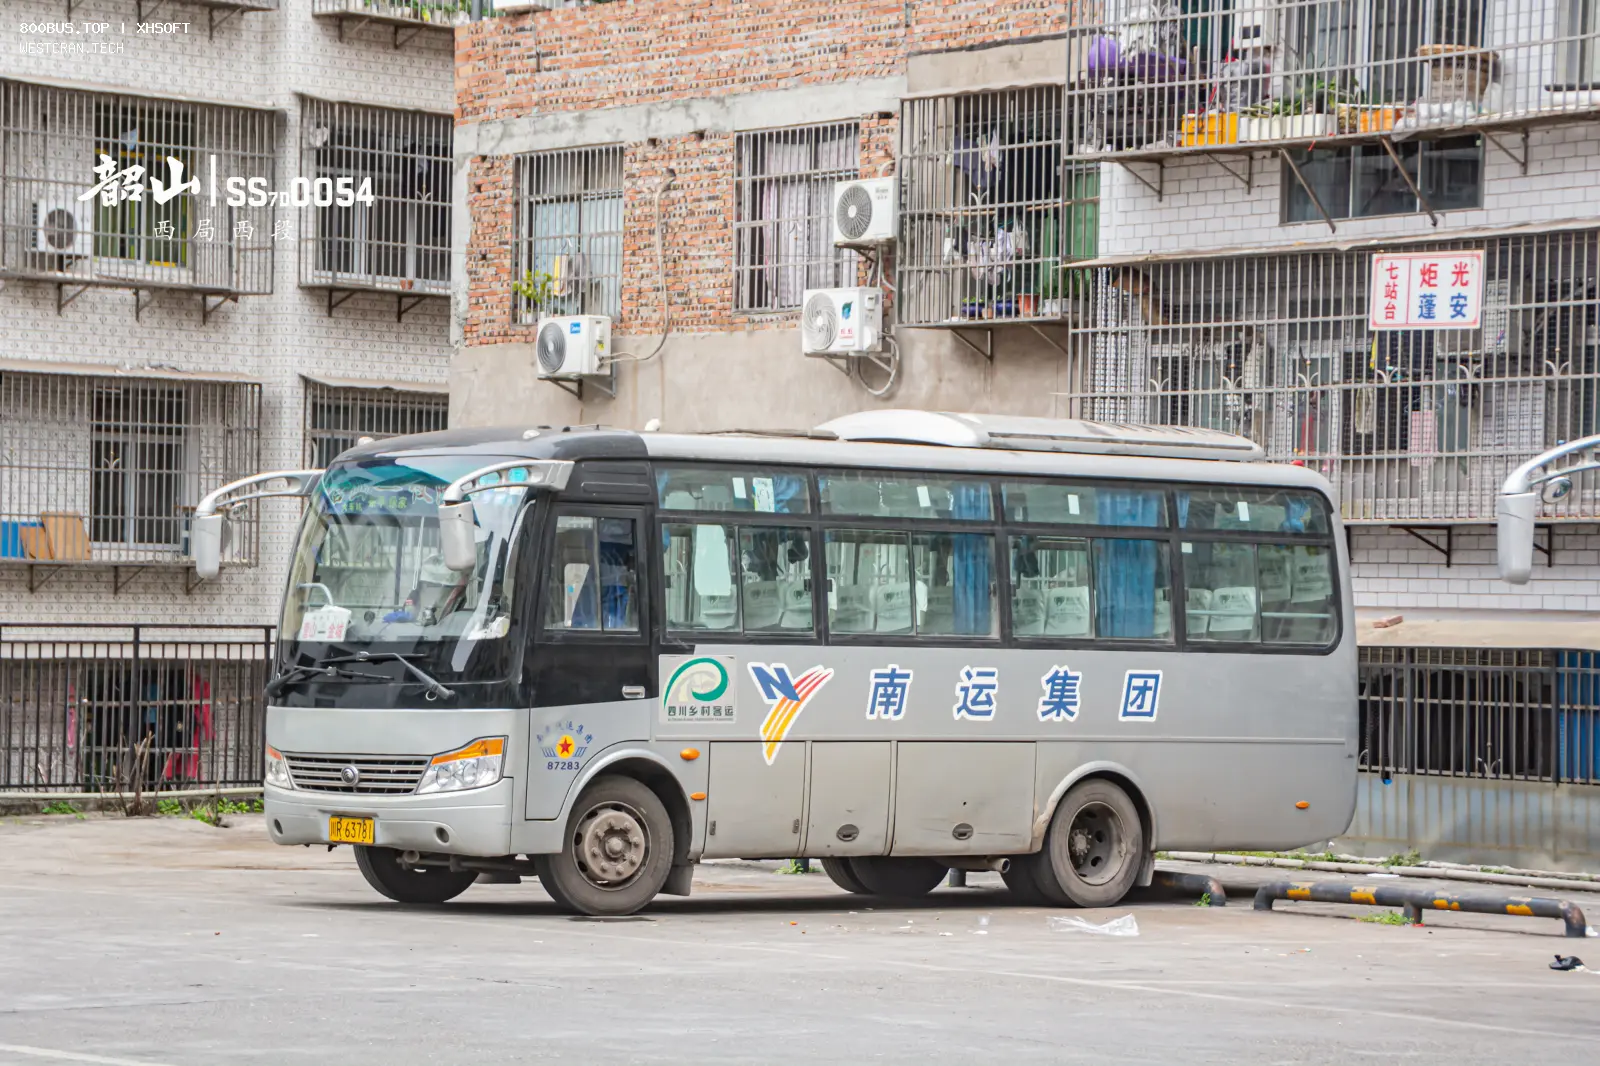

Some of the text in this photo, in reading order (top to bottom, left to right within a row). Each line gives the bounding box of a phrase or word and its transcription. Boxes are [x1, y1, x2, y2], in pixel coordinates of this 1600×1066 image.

[1383, 261, 1400, 321] 七站台
[867, 665, 1162, 720] 南运集团
[667, 705, 734, 717] 四川乡村客运
[547, 761, 580, 770] 87283
